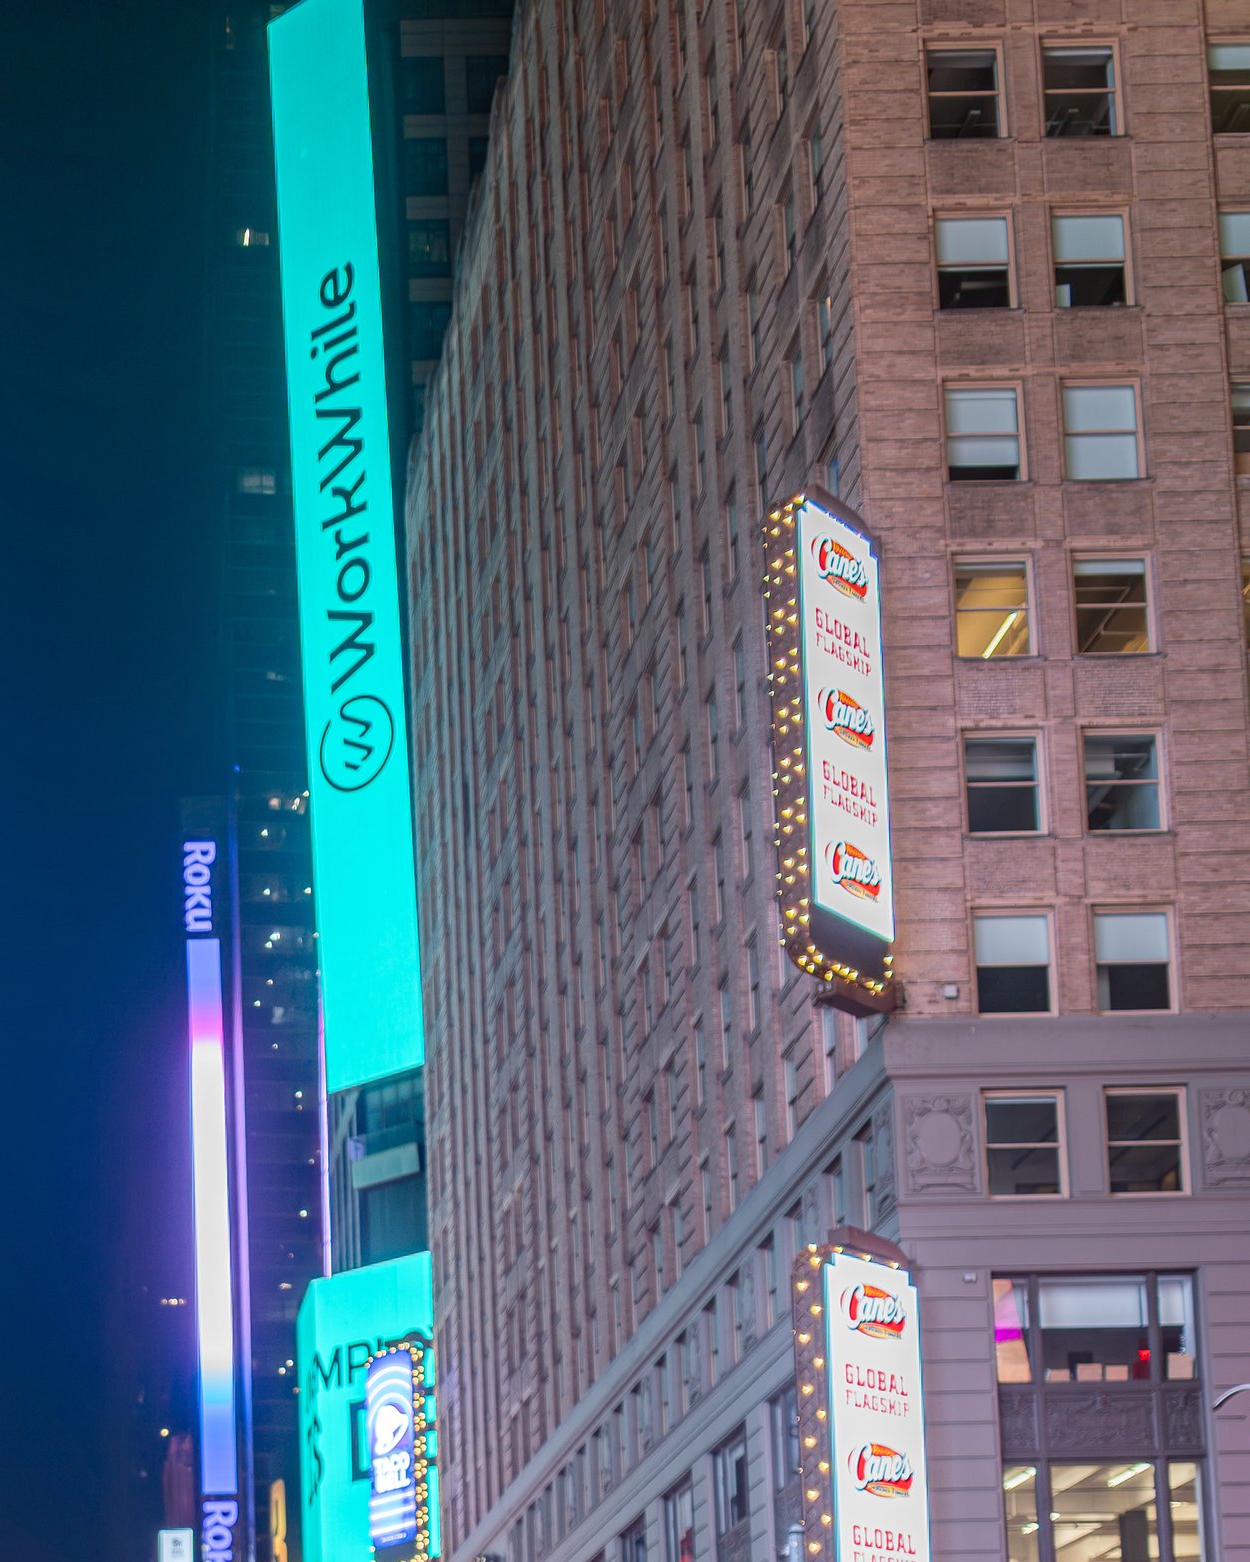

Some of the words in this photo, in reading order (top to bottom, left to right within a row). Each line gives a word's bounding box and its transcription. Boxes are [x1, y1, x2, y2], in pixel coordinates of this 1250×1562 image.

[311, 262, 379, 693] WorkWhile
[811, 532, 869, 587] Cane's
[815, 607, 870, 658] GLOBAL
[816, 632, 872, 677] FLAGSHIP
[818, 686, 875, 736] Cane's
[822, 760, 877, 808] GLOBAL
[823, 785, 878, 828] FLAGSHIP
[825, 839, 882, 889] Cane's
[840, 1283, 906, 1330] Cane's
[845, 1363, 909, 1397] GLOBAL
[845, 1389, 910, 1418] FLAGSHIP
[372, 1450, 411, 1475] TACO
[847, 1442, 914, 1491] Cane's
[852, 1524, 916, 1555] GLOBAL
